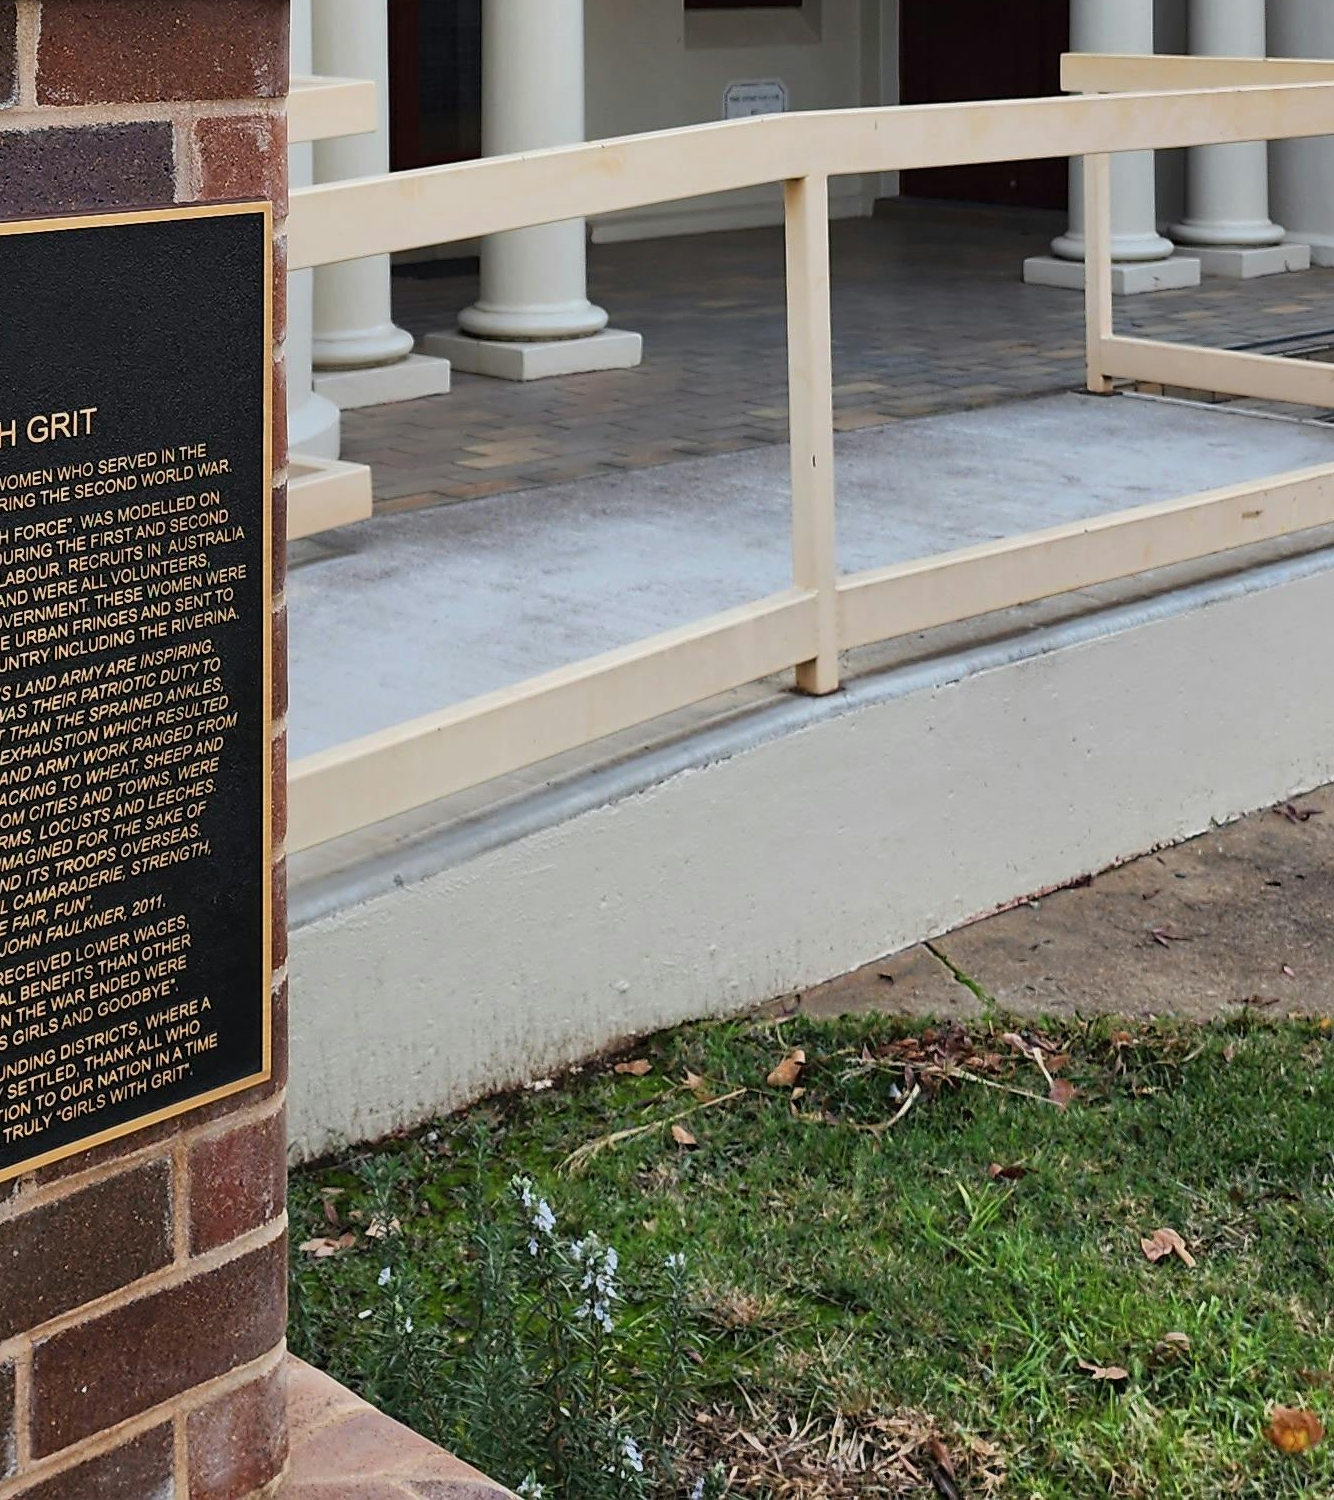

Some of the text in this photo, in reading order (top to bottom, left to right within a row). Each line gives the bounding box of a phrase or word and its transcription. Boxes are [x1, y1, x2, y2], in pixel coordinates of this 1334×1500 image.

[26, 407, 97, 442] GRIT
[39, 486, 70, 504] THE
[74, 475, 137, 498] SECOND
[140, 465, 193, 486] WORLD
[197, 458, 233, 477] WAR.
[56, 461, 93, 481] WHO
[97, 451, 156, 474] SERVED
[161, 448, 174, 463] IN
[178, 442, 206, 460] THE
[56, 535, 86, 554] THE
[91, 526, 133, 548] FIRST
[135, 521, 165, 539] AND
[170, 509, 228, 532] SECOND
[68, 545, 142, 573] RECRUITS
[147, 542, 160, 557] IN
[167, 526, 244, 553] AUSTRALIA
[54, 629, 134, 660] INCLUDING
[138, 621, 167, 640] THE
[171, 606, 239, 633] RIVERINA.
[31, 691, 76, 714] THEIR
[80, 672, 156, 703] PATRIOTIC
[159, 661, 199, 684] DUTY
[202, 656, 220, 673] TO
[0, 726, 99, 765] EXHAUSTION
[103, 714, 152, 739] WHICH
[155, 695, 228, 726] RESULTED
[76, 828, 108, 850] FOR
[112, 818, 141, 839] THE
[144, 806, 183, 830] SAKE
[186, 800, 206, 818] OF
[45, 905, 126, 942] FAULKNER,
[131, 894, 165, 916] 2011.
[75, 932, 129, 962] LOWER
[133, 914, 189, 943] WAGES,
[15, 1000, 45, 1022] THE
[50, 988, 85, 1011] WAR
[89, 970, 140, 999] ENDED
[144, 954, 186, 980] WERE
[20, 964, 93, 1001] BENEFITS
[97, 950, 137, 974] THAN
[141, 933, 190, 961] OTHER
[60, 1020, 141, 1060] DISTRICTS,
[145, 999, 197, 1029] WHERE
[200, 996, 210, 1011] A
[7, 1063, 79, 1099] SETTLED,
[83, 1042, 133, 1071] THANK
[136, 1033, 161, 1053] ALL
[165, 1019, 200, 1042] WHO
